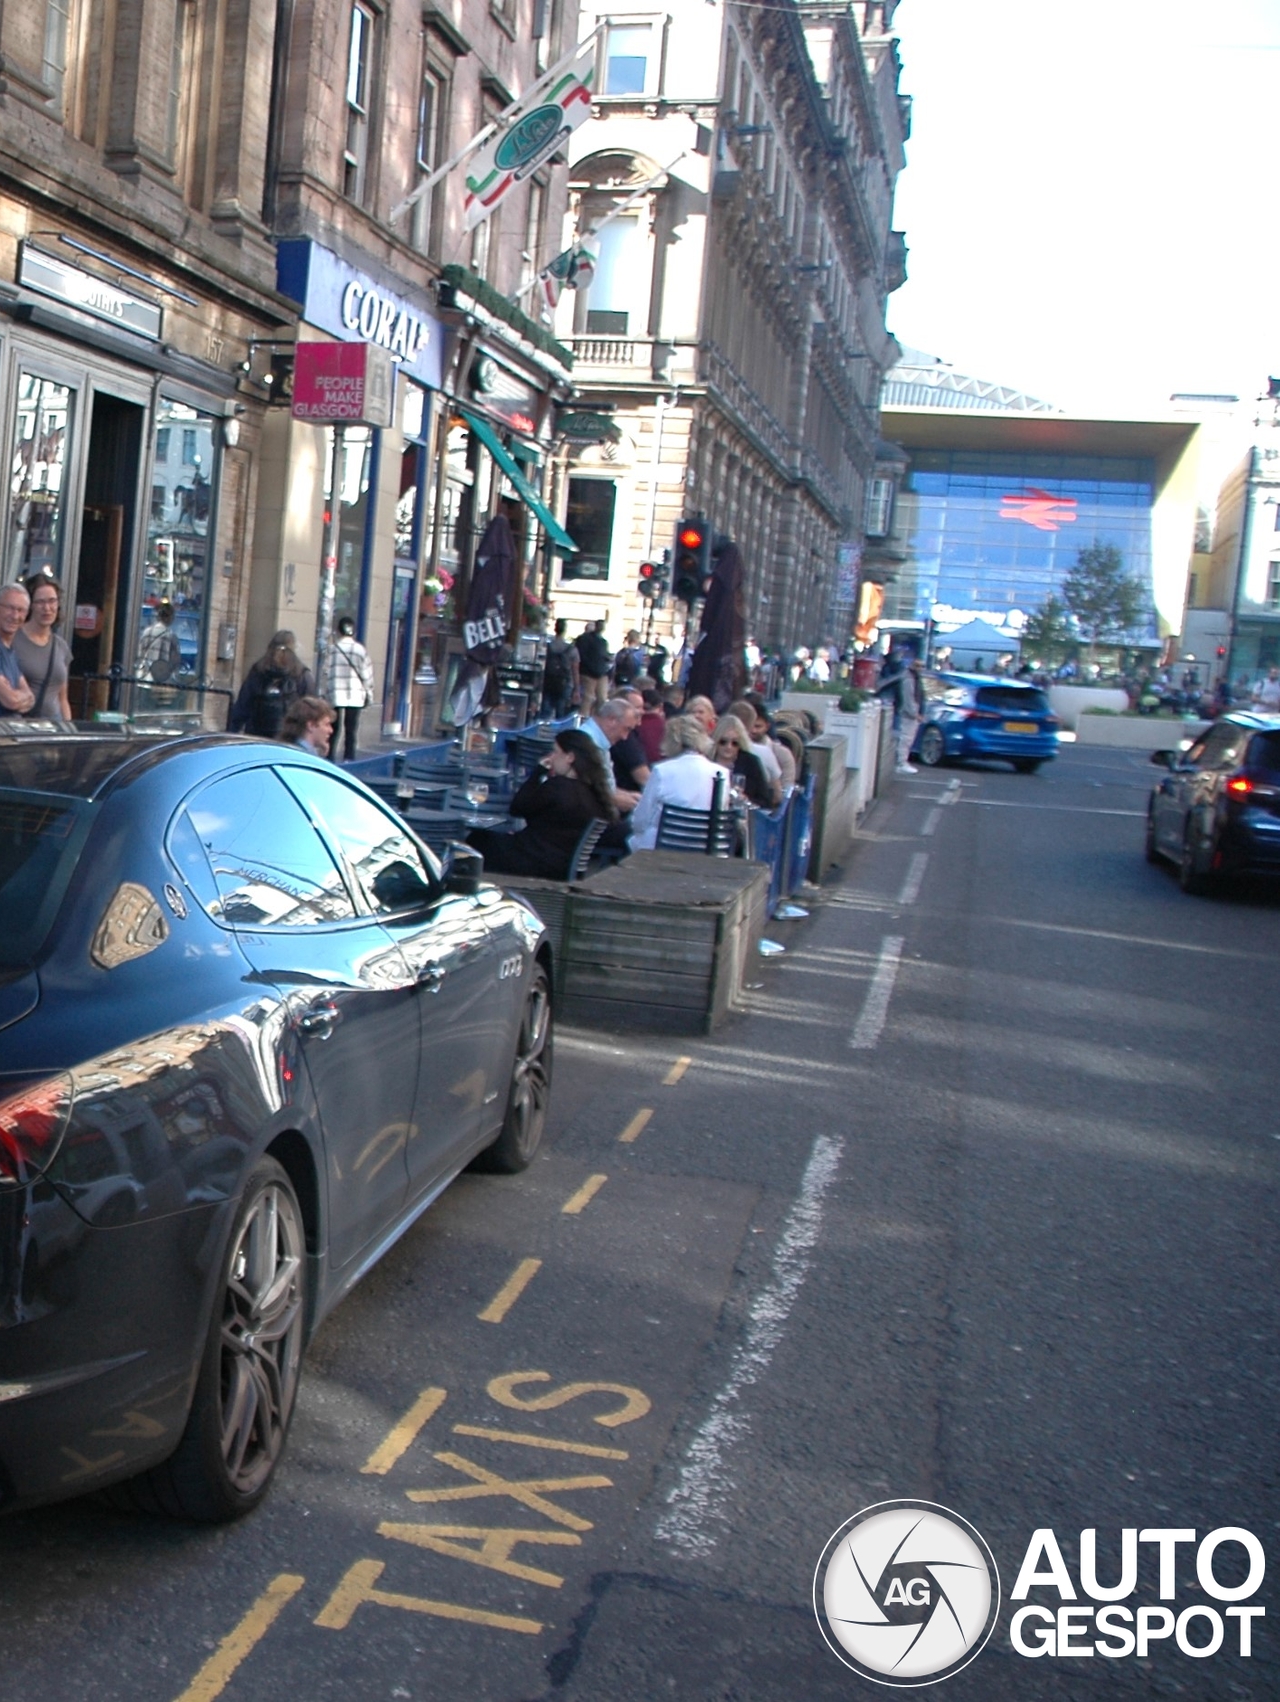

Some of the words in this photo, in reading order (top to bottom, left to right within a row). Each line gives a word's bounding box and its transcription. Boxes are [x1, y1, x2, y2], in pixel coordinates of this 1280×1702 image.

[341, 279, 419, 364] CORAL
[314, 376, 364, 391] PEOPLE
[324, 390, 363, 404] MAKE
[293, 402, 362, 417] GLASGOW
[312, 1370, 653, 1635] TAXIS
